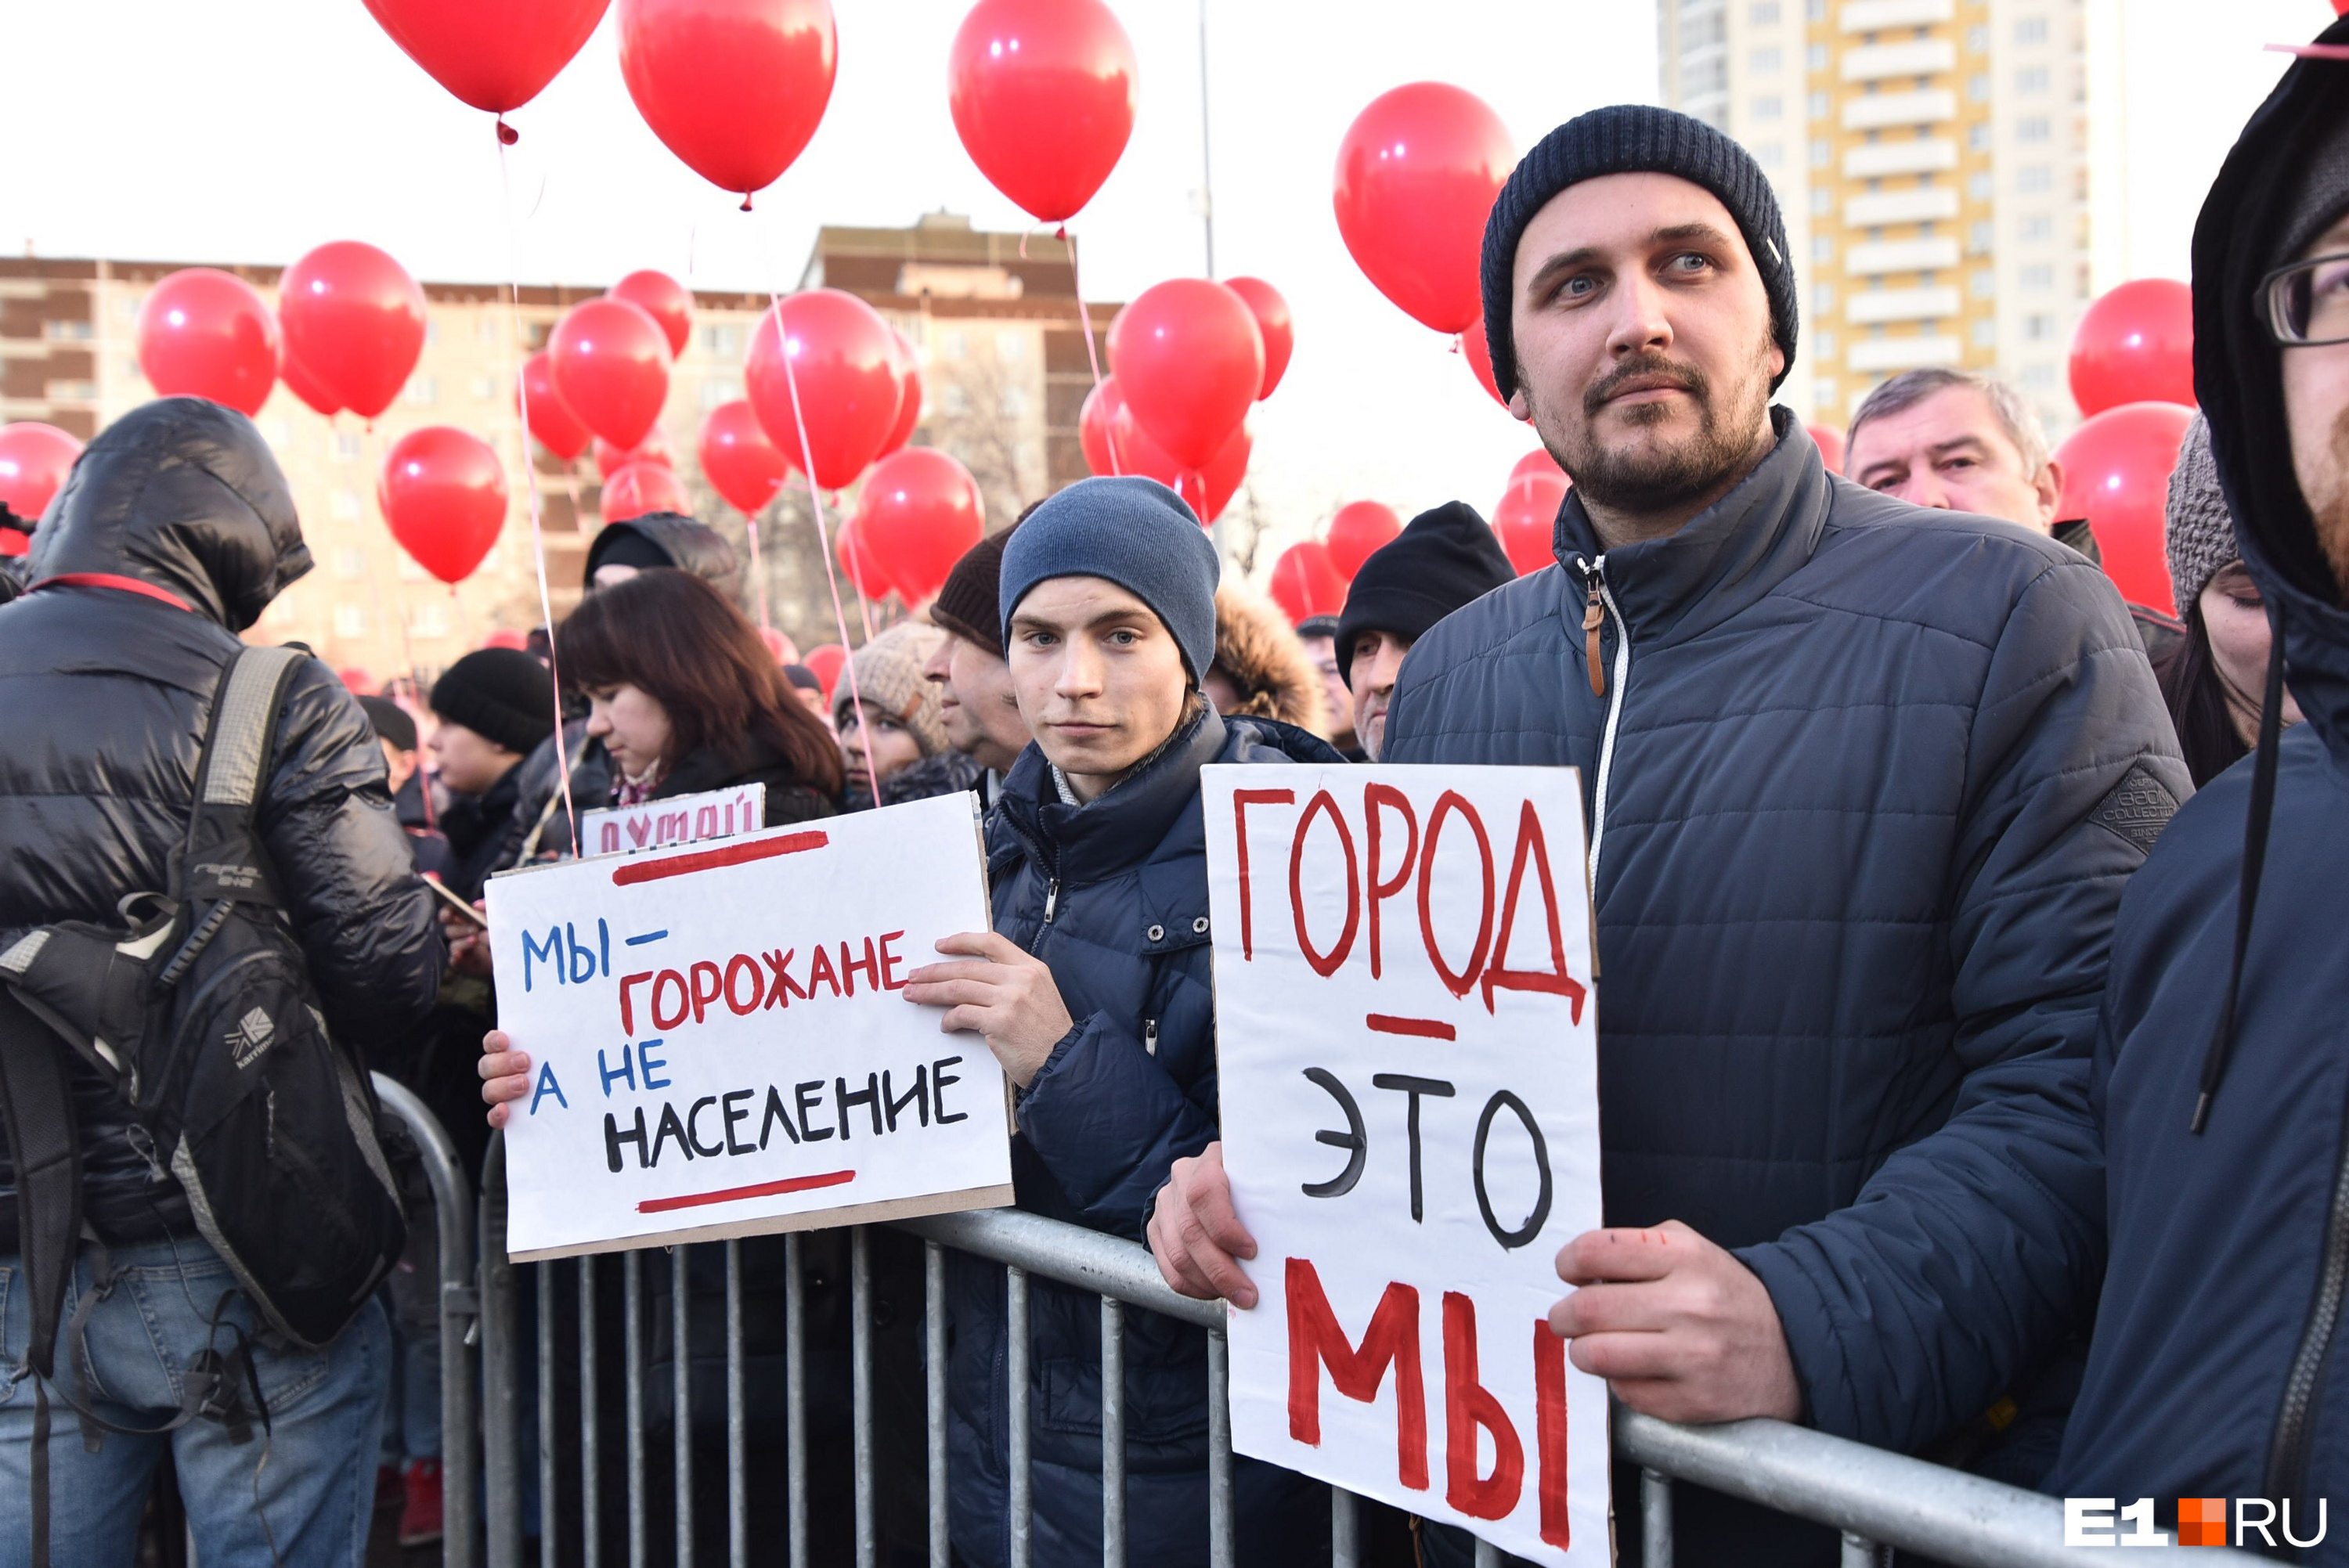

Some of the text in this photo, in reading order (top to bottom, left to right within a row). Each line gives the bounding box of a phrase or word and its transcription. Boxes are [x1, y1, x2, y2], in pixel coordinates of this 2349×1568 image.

[2102, 806, 2175, 821] COLLECTIO
[1234, 781, 1586, 1026] ГОРОД
[619, 930, 909, 1036] ГОРОЖАНЕ
[530, 1038, 672, 1116] А НЕ
[604, 1056, 968, 1173] НАСЕЛЕНИЕ
[1301, 1066, 1552, 1252] ЭТО
[1285, 1257, 1569, 1552] МЫ
